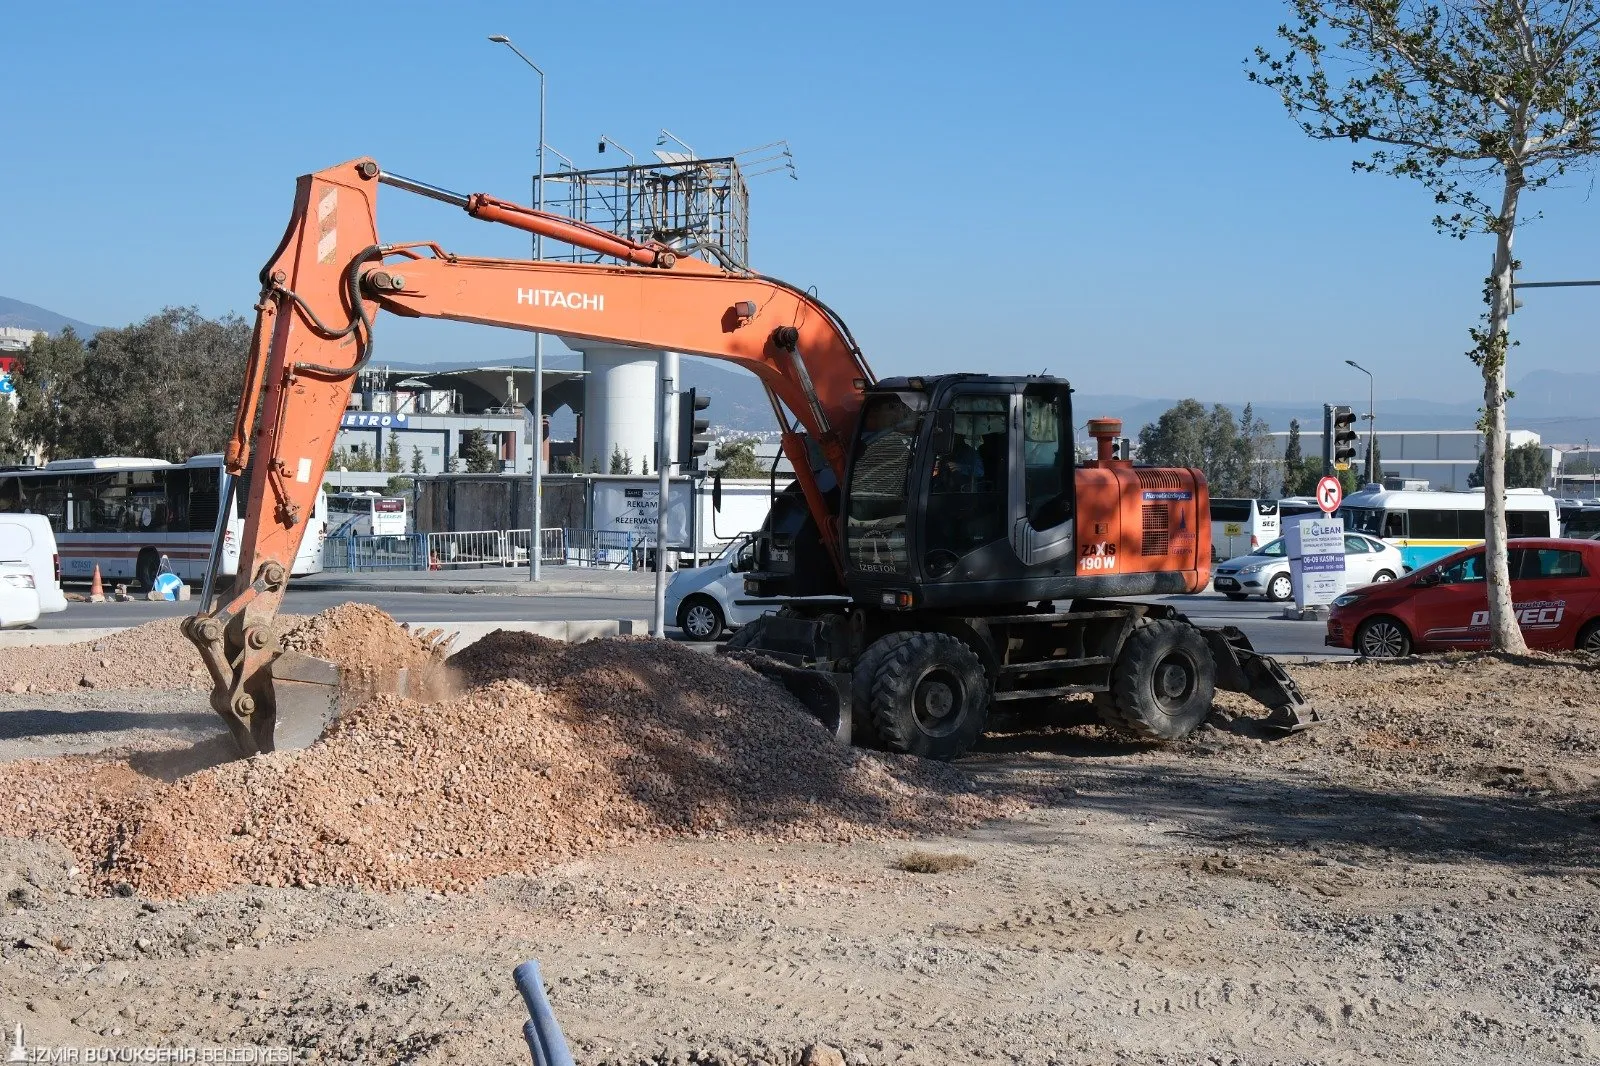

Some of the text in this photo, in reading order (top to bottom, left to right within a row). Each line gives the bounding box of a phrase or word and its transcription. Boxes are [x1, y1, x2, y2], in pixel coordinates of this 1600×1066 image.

[517, 287, 604, 311] HITACHI
[341, 414, 392, 426] ETRO
[1081, 541, 1116, 557] ZAXIS
[1080, 556, 1116, 570] 190 W
[1319, 555, 1335, 563] KASIM
